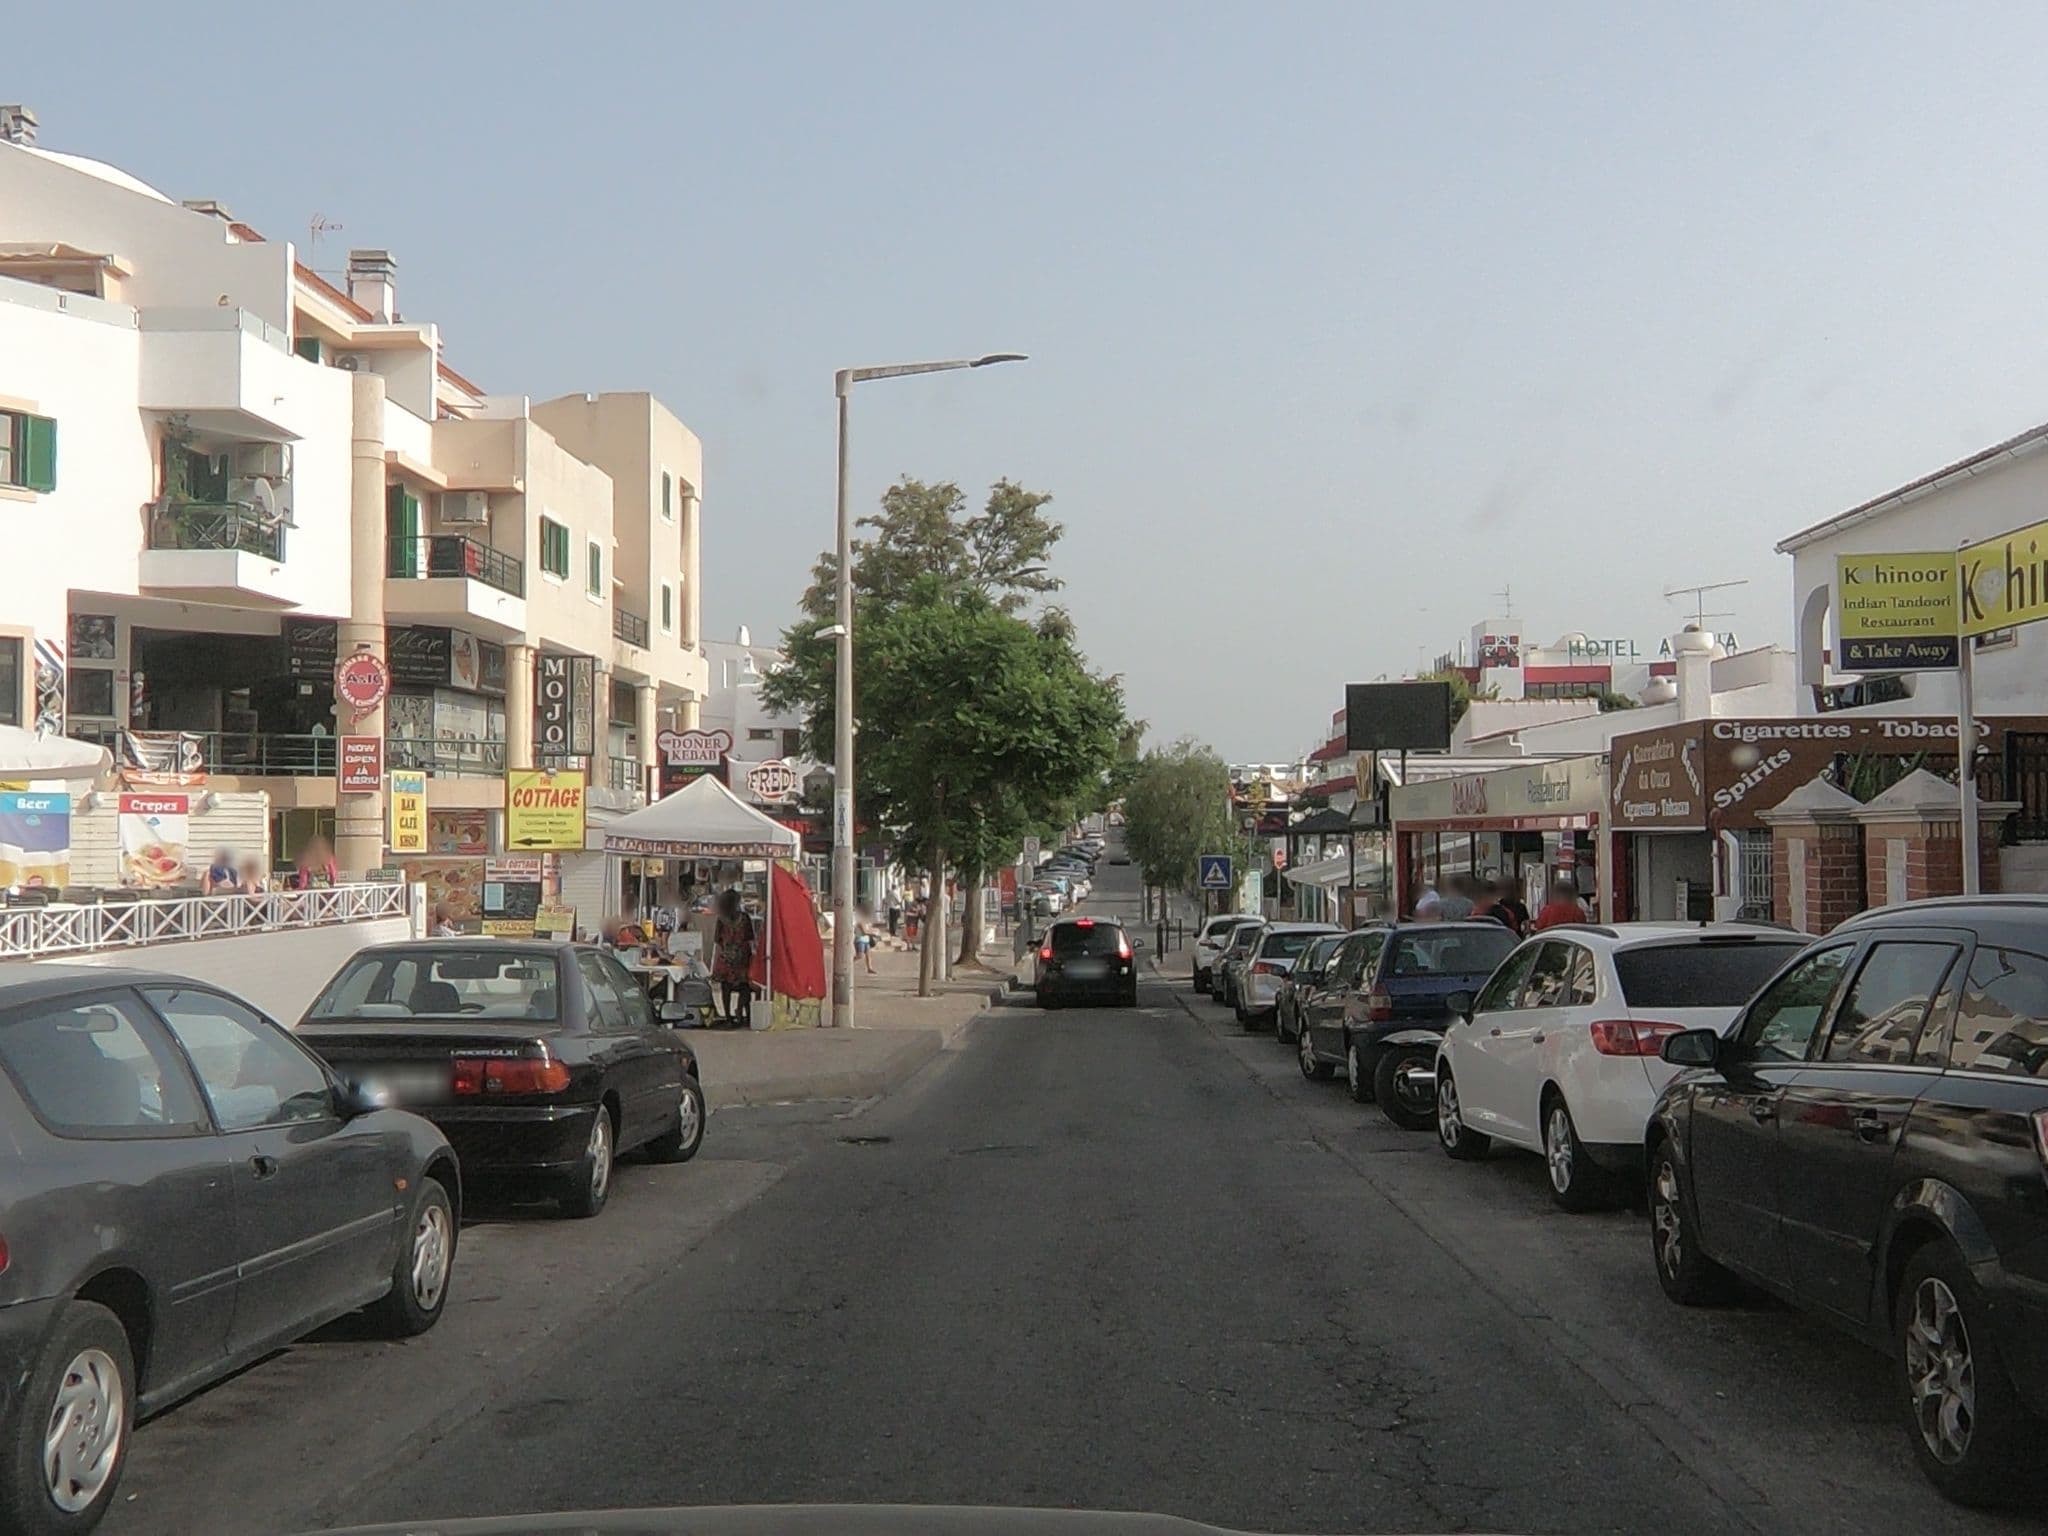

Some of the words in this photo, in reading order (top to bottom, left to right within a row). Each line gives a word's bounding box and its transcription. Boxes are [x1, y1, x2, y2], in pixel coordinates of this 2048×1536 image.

[1844, 564, 1949, 584] Khinoor
[1961, 540, 2048, 625] Khi
[1843, 597, 1887, 610] Indian
[1890, 595, 1951, 609] Tandoori
[1860, 616, 1936, 628] Restaurant
[1568, 639, 1641, 658] HOTEL
[1850, 646, 1863, 659] &
[1866, 643, 1903, 659] Take
[1905, 643, 1951, 661] Away
[544, 658, 566, 743] MOJO
[1712, 721, 1851, 742] Cigarettes
[1878, 720, 1991, 738] Tobaco
[346, 744, 376, 752] NOW
[672, 738, 722, 749] DONER
[345, 756, 377, 764] OPEN
[672, 750, 718, 761] KEBAB
[344, 776, 379, 784] ABRIU
[1712, 747, 1792, 809] Spirits
[513, 787, 581, 808] COTTAGE
[1527, 776, 1570, 804] Restaurant
[16, 797, 51, 810] Beer
[130, 799, 178, 813] Crepes
